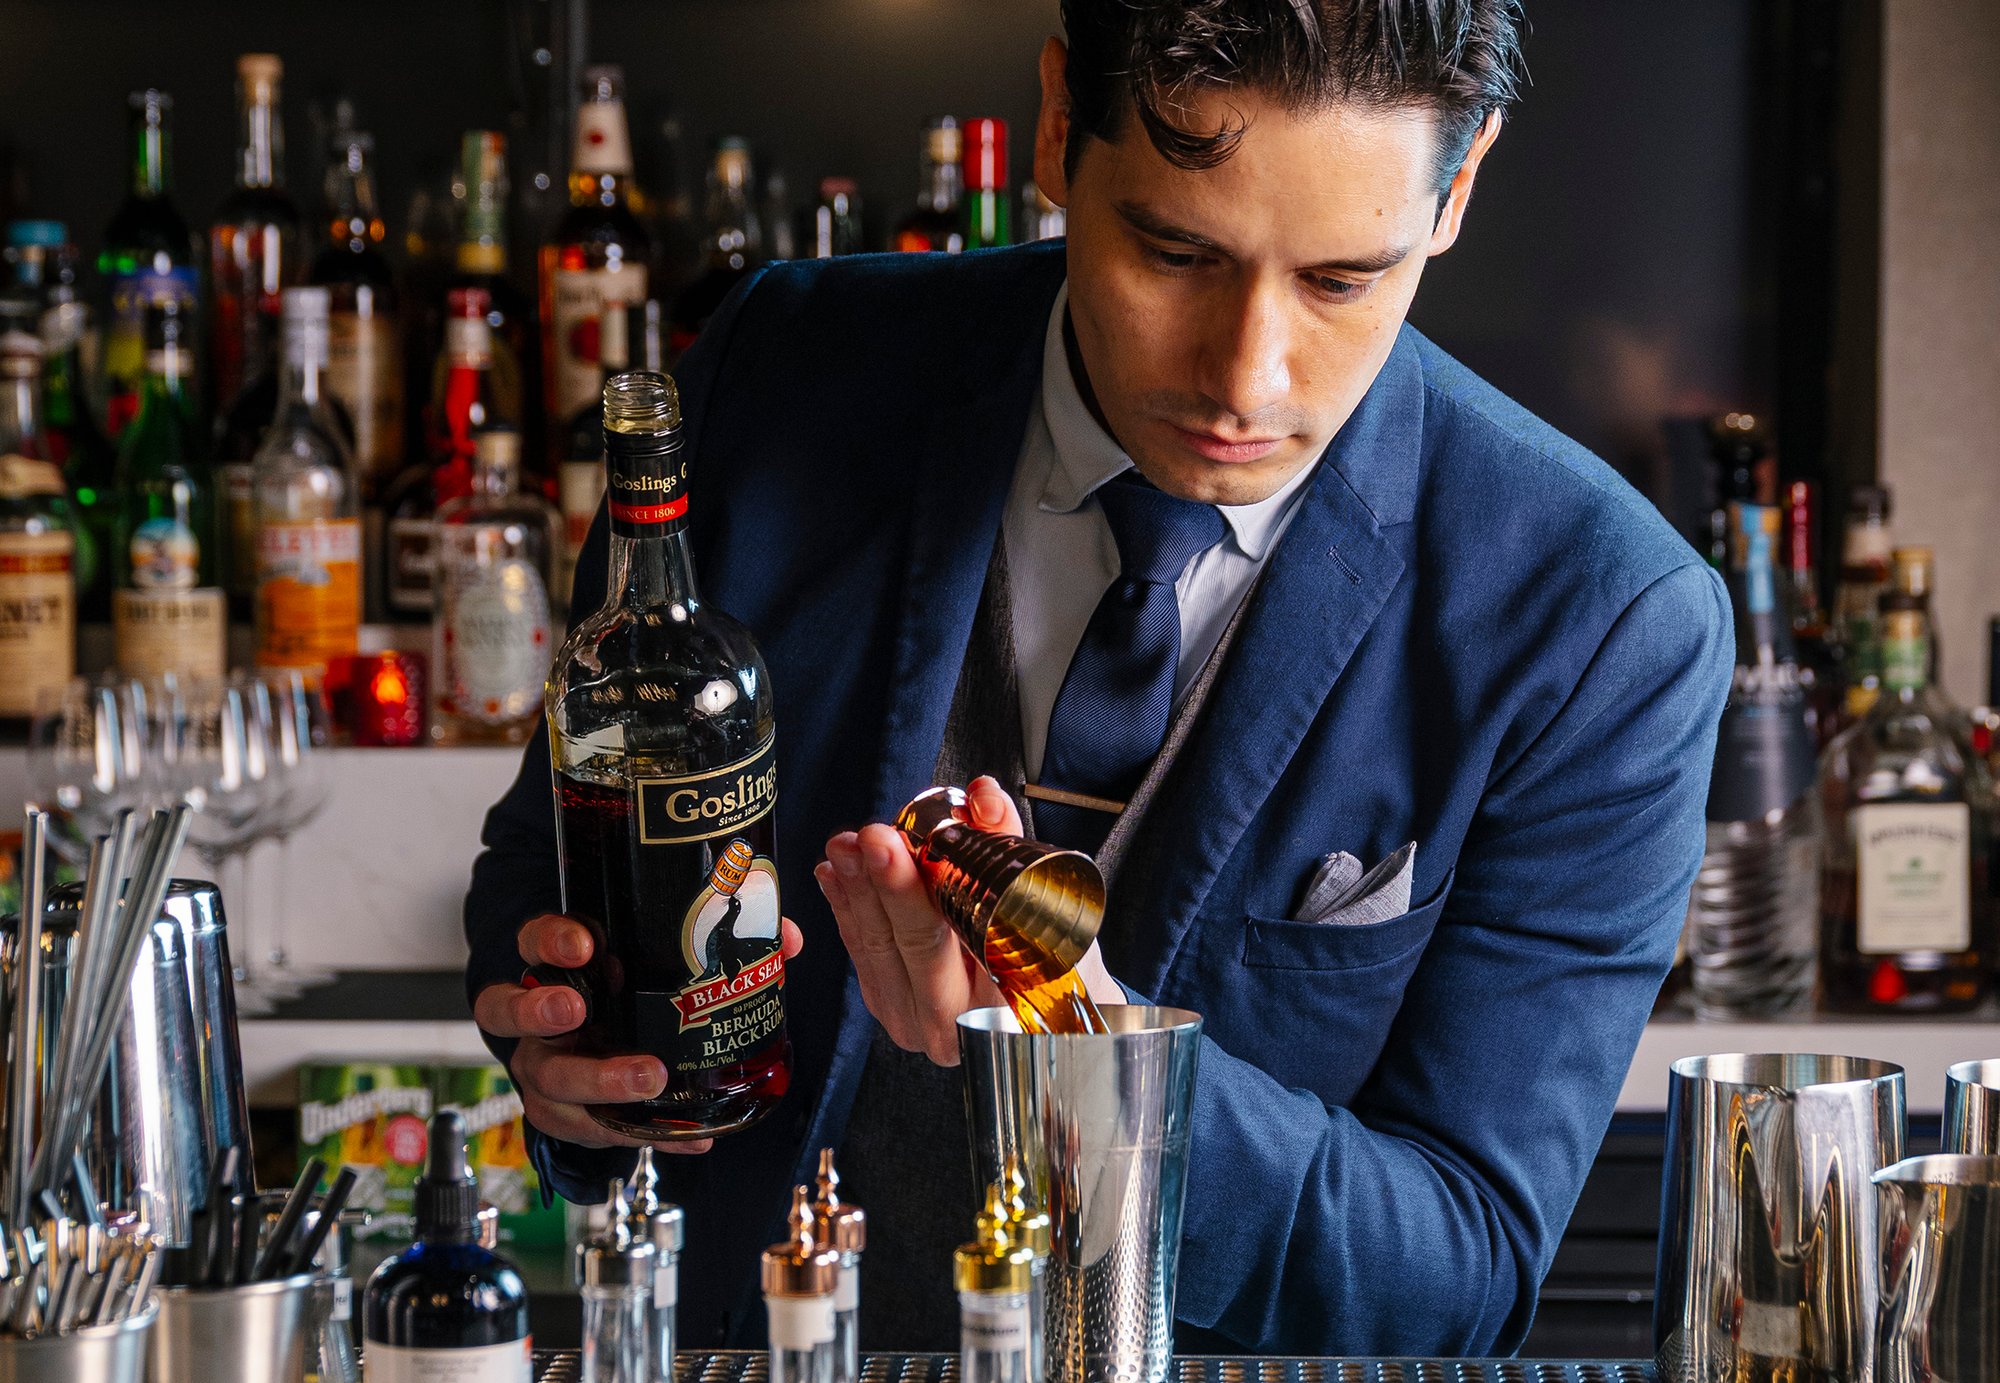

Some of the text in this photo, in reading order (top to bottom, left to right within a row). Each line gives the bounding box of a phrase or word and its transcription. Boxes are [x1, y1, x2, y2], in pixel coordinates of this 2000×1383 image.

[613, 472, 677, 493] Goslings
[654, 506, 676, 519] 1806
[666, 760, 776, 822] Goslings
[718, 801, 761, 827] Since 1806
[719, 863, 741, 881] RUM
[691, 955, 783, 1008] BLACK SEAL
[743, 993, 767, 1011] PROOF
[711, 995, 780, 1037] BERMUDA
[703, 1005, 784, 1056] BLACK RUM
[677, 1061, 698, 1071] 40%
